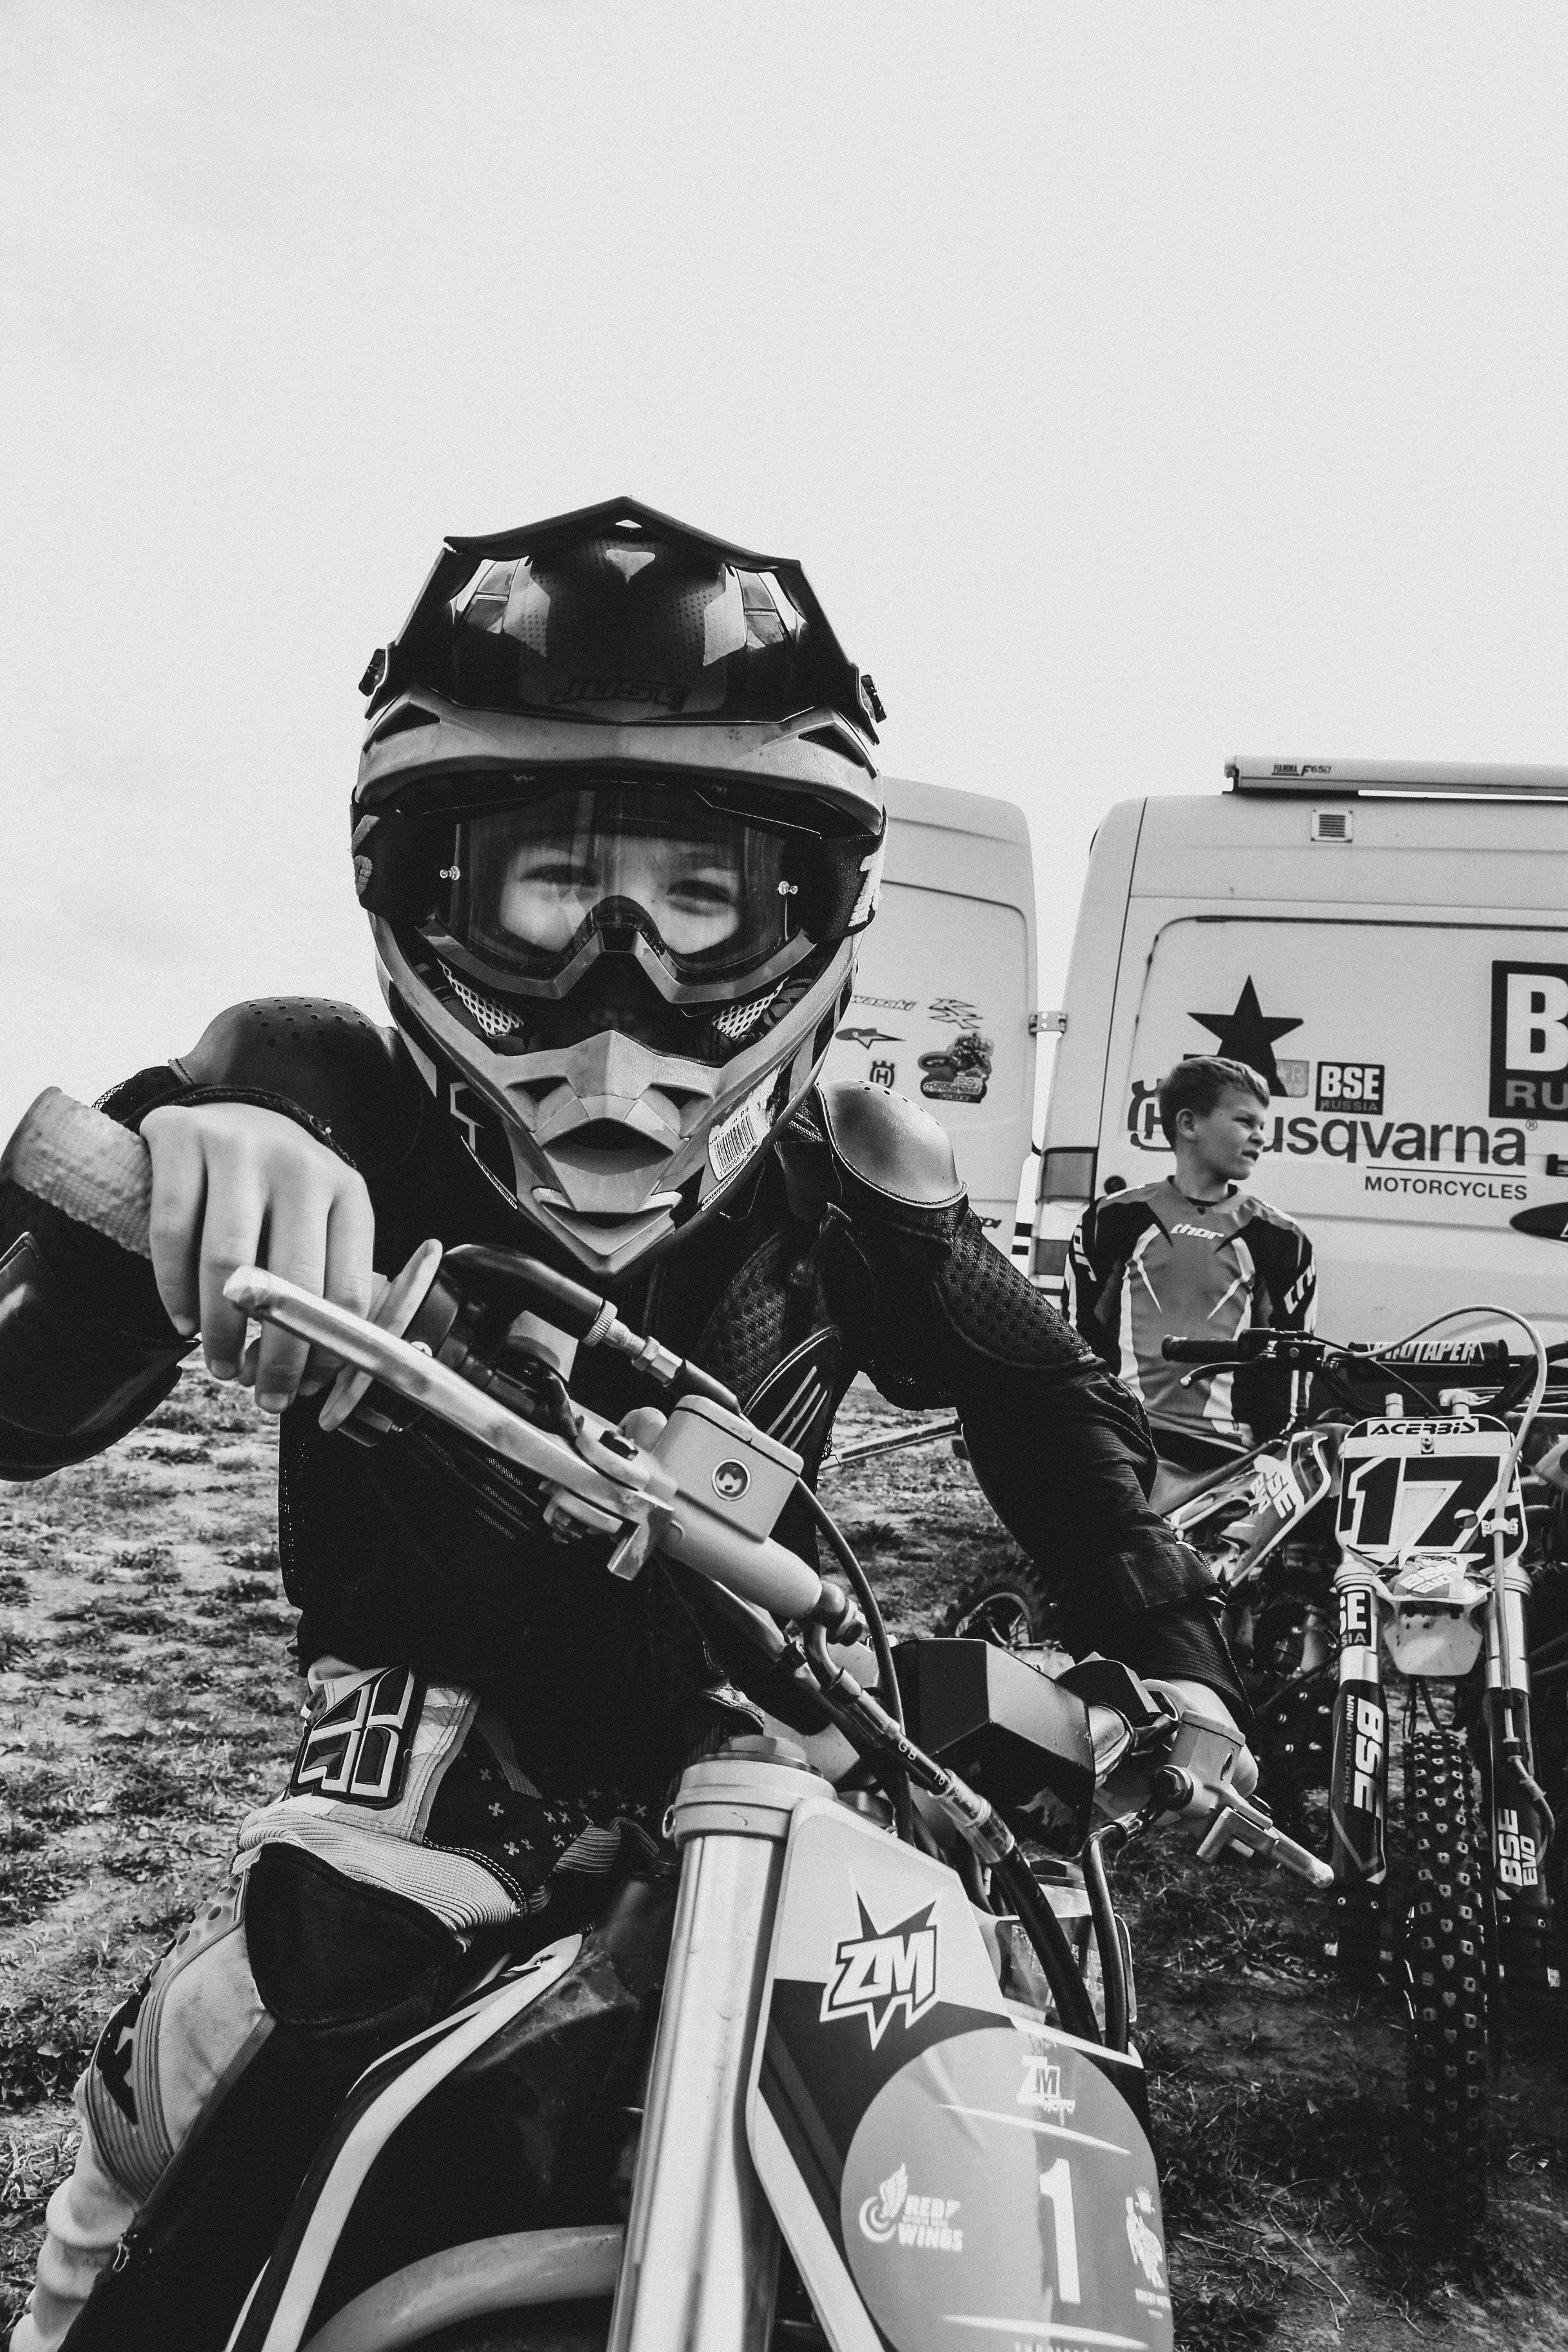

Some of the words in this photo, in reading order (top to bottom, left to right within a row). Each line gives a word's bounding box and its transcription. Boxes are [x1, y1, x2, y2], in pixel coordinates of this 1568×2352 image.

[1320, 1065, 1380, 1100] BSE
[1319, 1099, 1378, 1112] RUSSIA
[1364, 1175, 1527, 1200] MOTORCYCLES
[1170, 1224, 1224, 1240] thor
[1369, 1422, 1476, 1435] ACERBIS
[1352, 1455, 1501, 1547] 17
[1354, 1697, 1384, 1821] BSE
[1497, 1807, 1524, 1886] BSE
[1519, 1834, 1538, 1886] EVO
[832, 1925, 937, 2017] ZM
[897, 2221, 964, 2252] WINGS
[1039, 2158, 1081, 2305] 1
